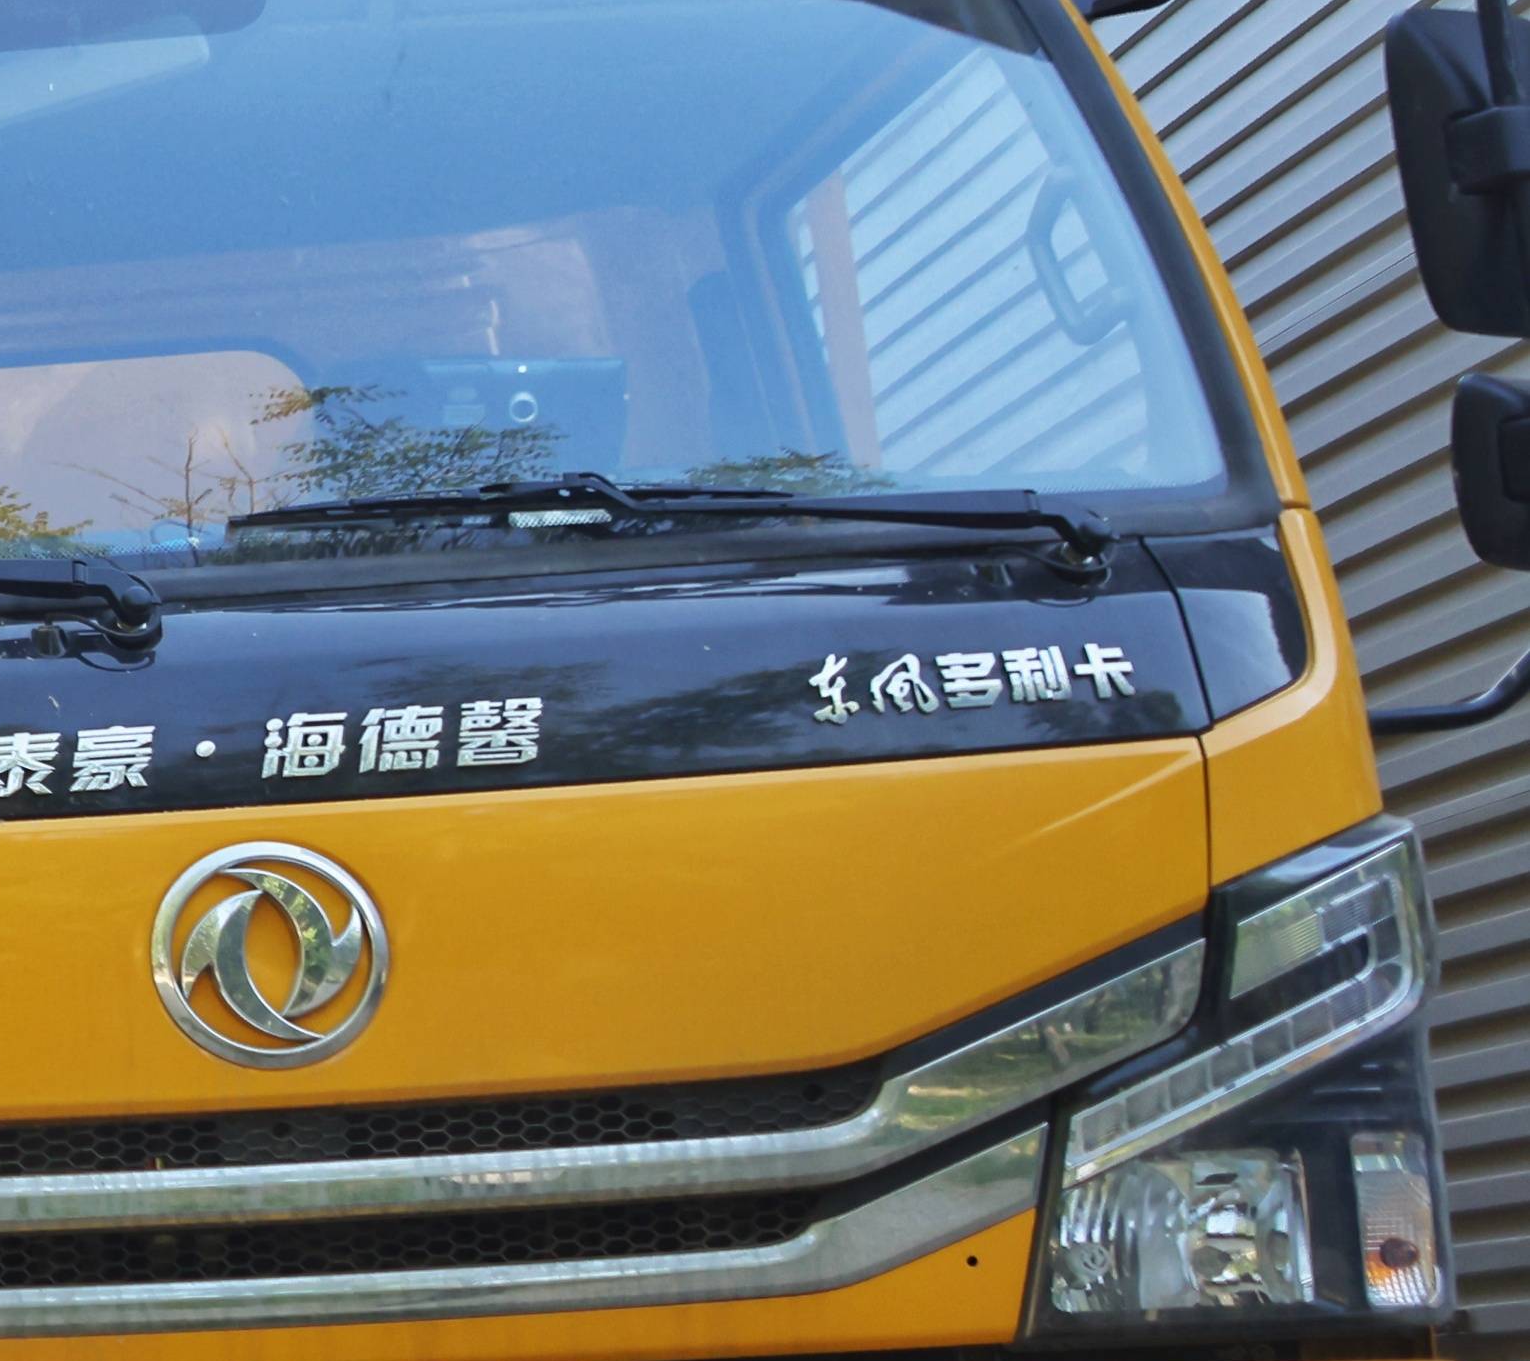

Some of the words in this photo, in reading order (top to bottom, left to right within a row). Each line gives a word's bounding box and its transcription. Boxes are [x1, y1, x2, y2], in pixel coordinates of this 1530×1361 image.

[809, 643, 1135, 725] 东风多利卡
